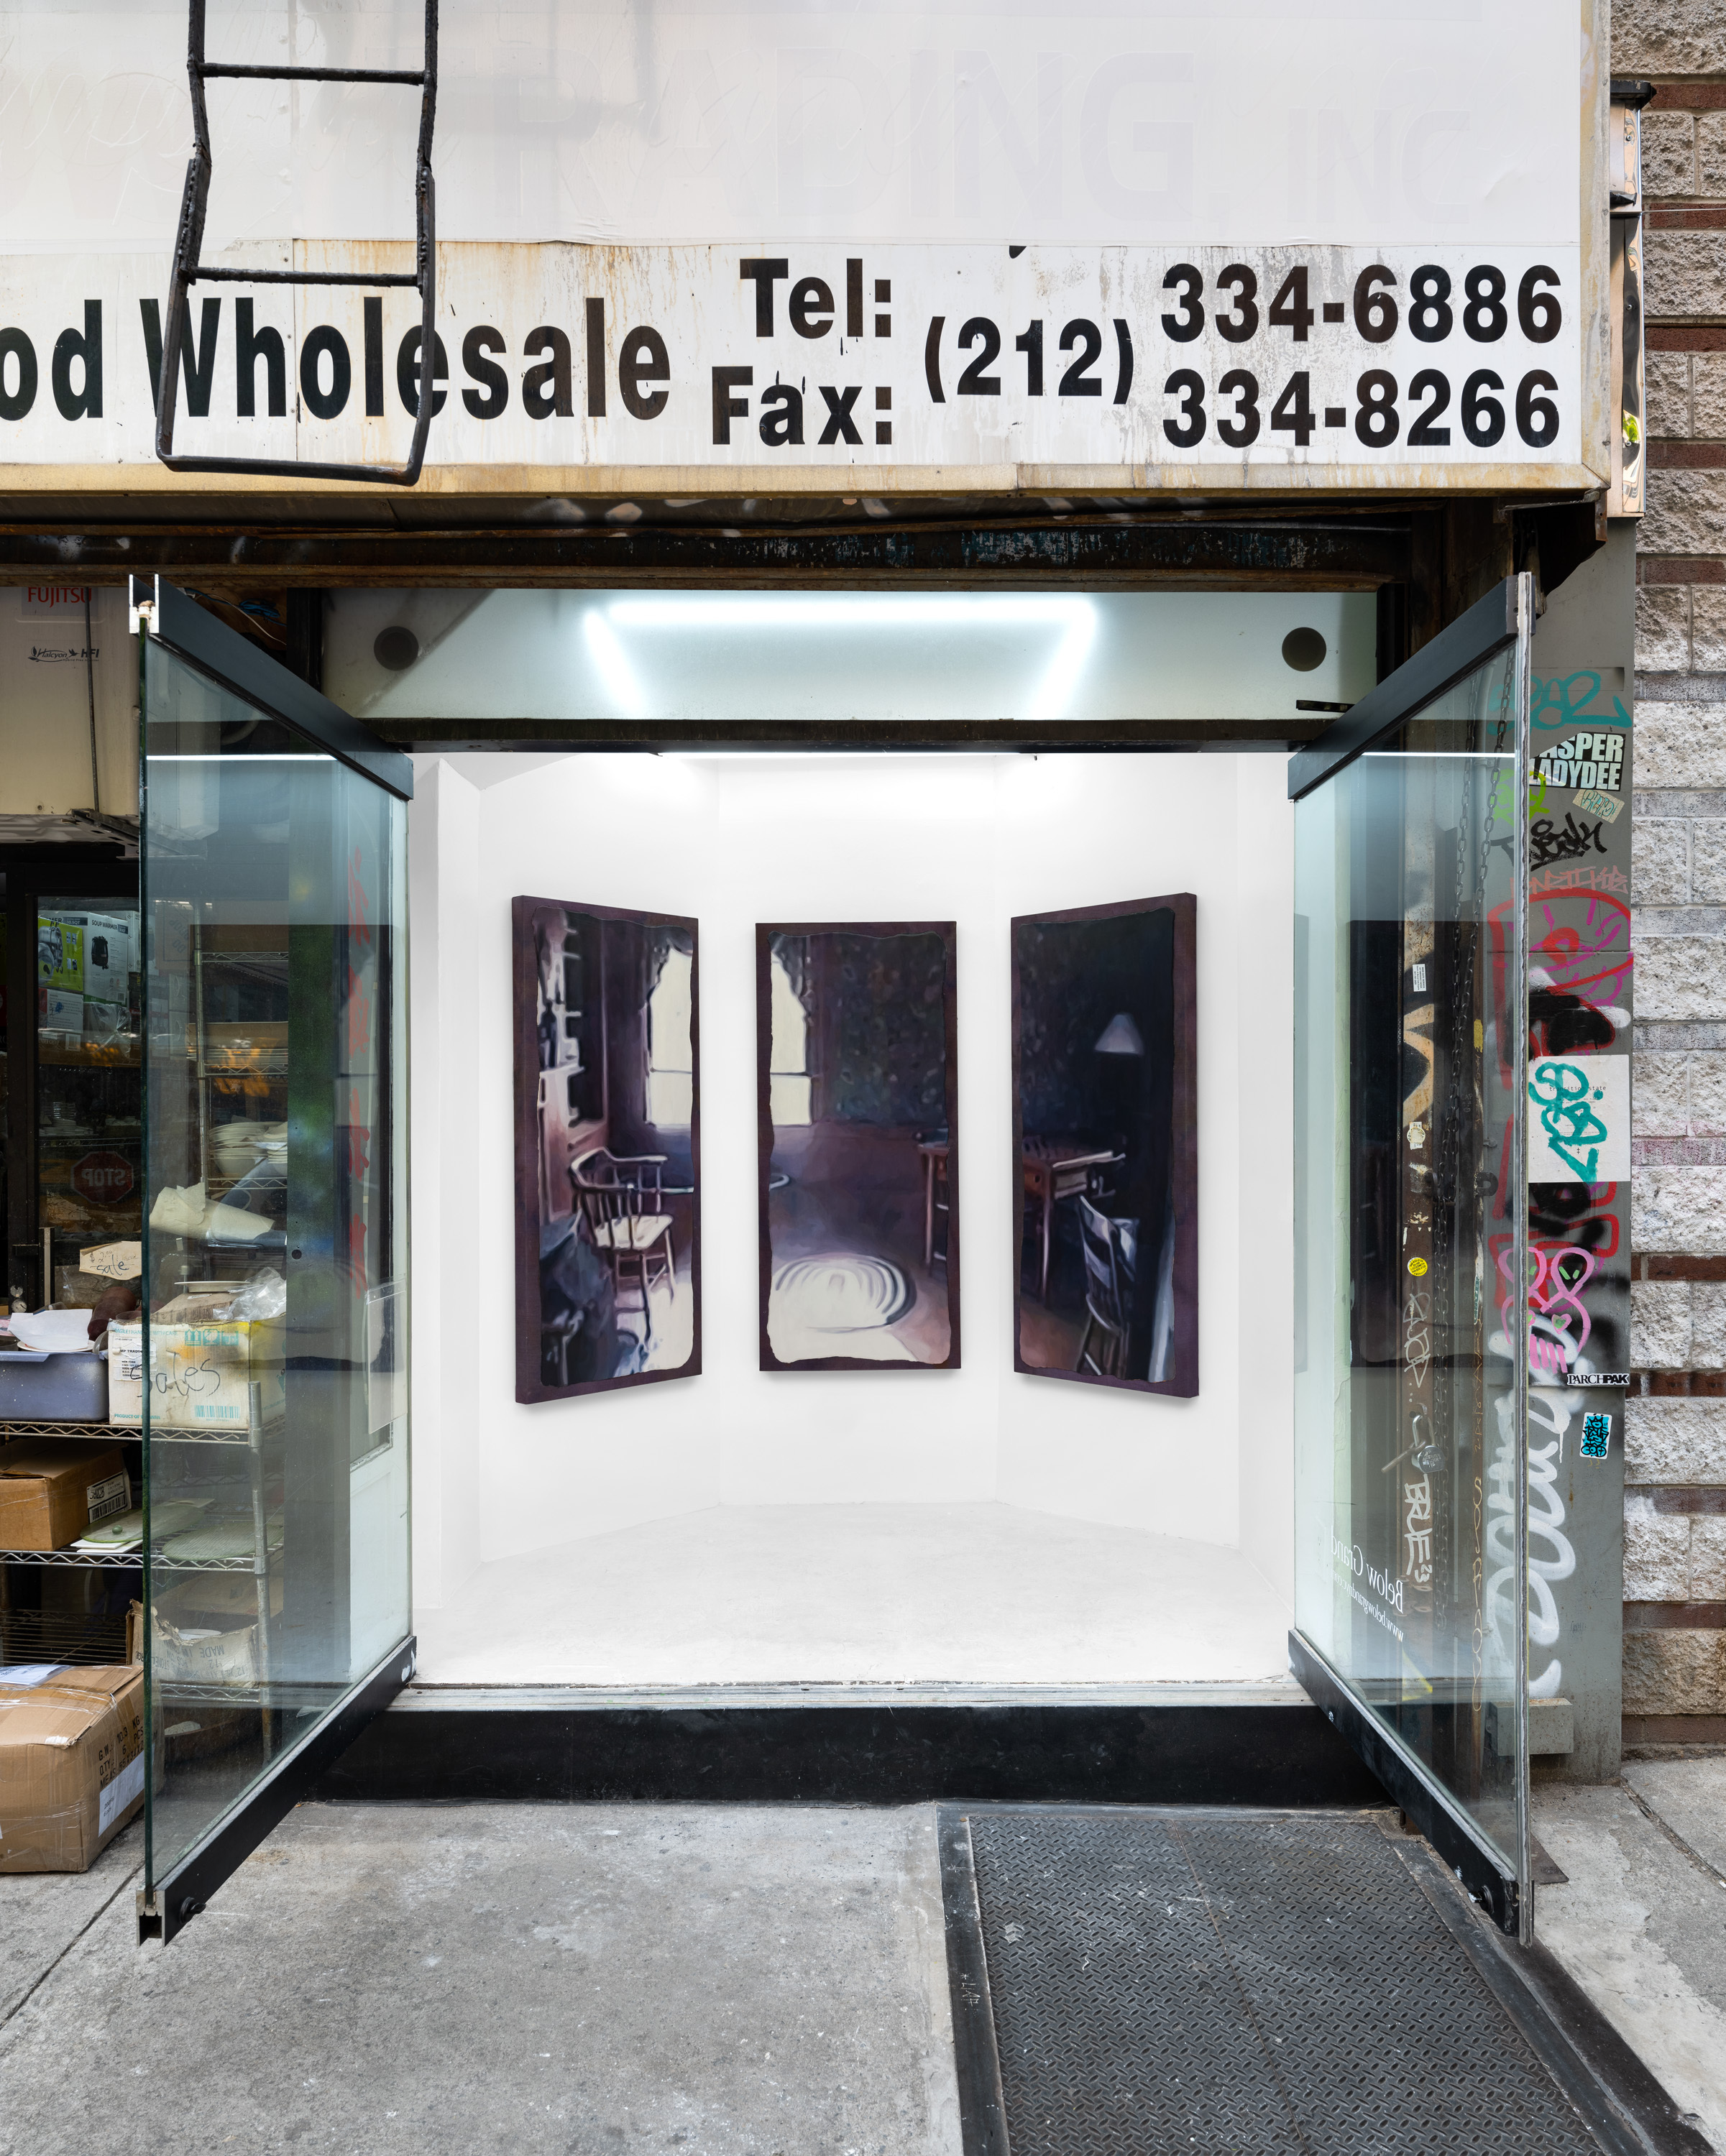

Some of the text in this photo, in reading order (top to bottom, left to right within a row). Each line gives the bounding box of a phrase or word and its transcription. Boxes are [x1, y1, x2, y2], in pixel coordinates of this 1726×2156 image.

[740, 258, 891, 339] Tel:
[1161, 262, 1562, 344] 334-6886
[139, 297, 671, 421] Wholesale
[924, 316, 1134, 405] (212)
[712, 366, 893, 447] Fax:
[1162, 369, 1559, 448] 334-8266
[27, 586, 93, 608] FUJITSU
[37, 648, 68, 659] Halcyon
[1529, 758, 1622, 791] LADYDEE
[96, 1254, 129, 1276] sale
[1568, 1374, 1628, 1384] PARCHPAK
[199, 1644, 225, 1659] MADE
[116, 1726, 128, 1744] 10.3
[132, 1715, 140, 1730] KG
[122, 1743, 127, 1755] 6
[134, 1726, 144, 1744] PCS
